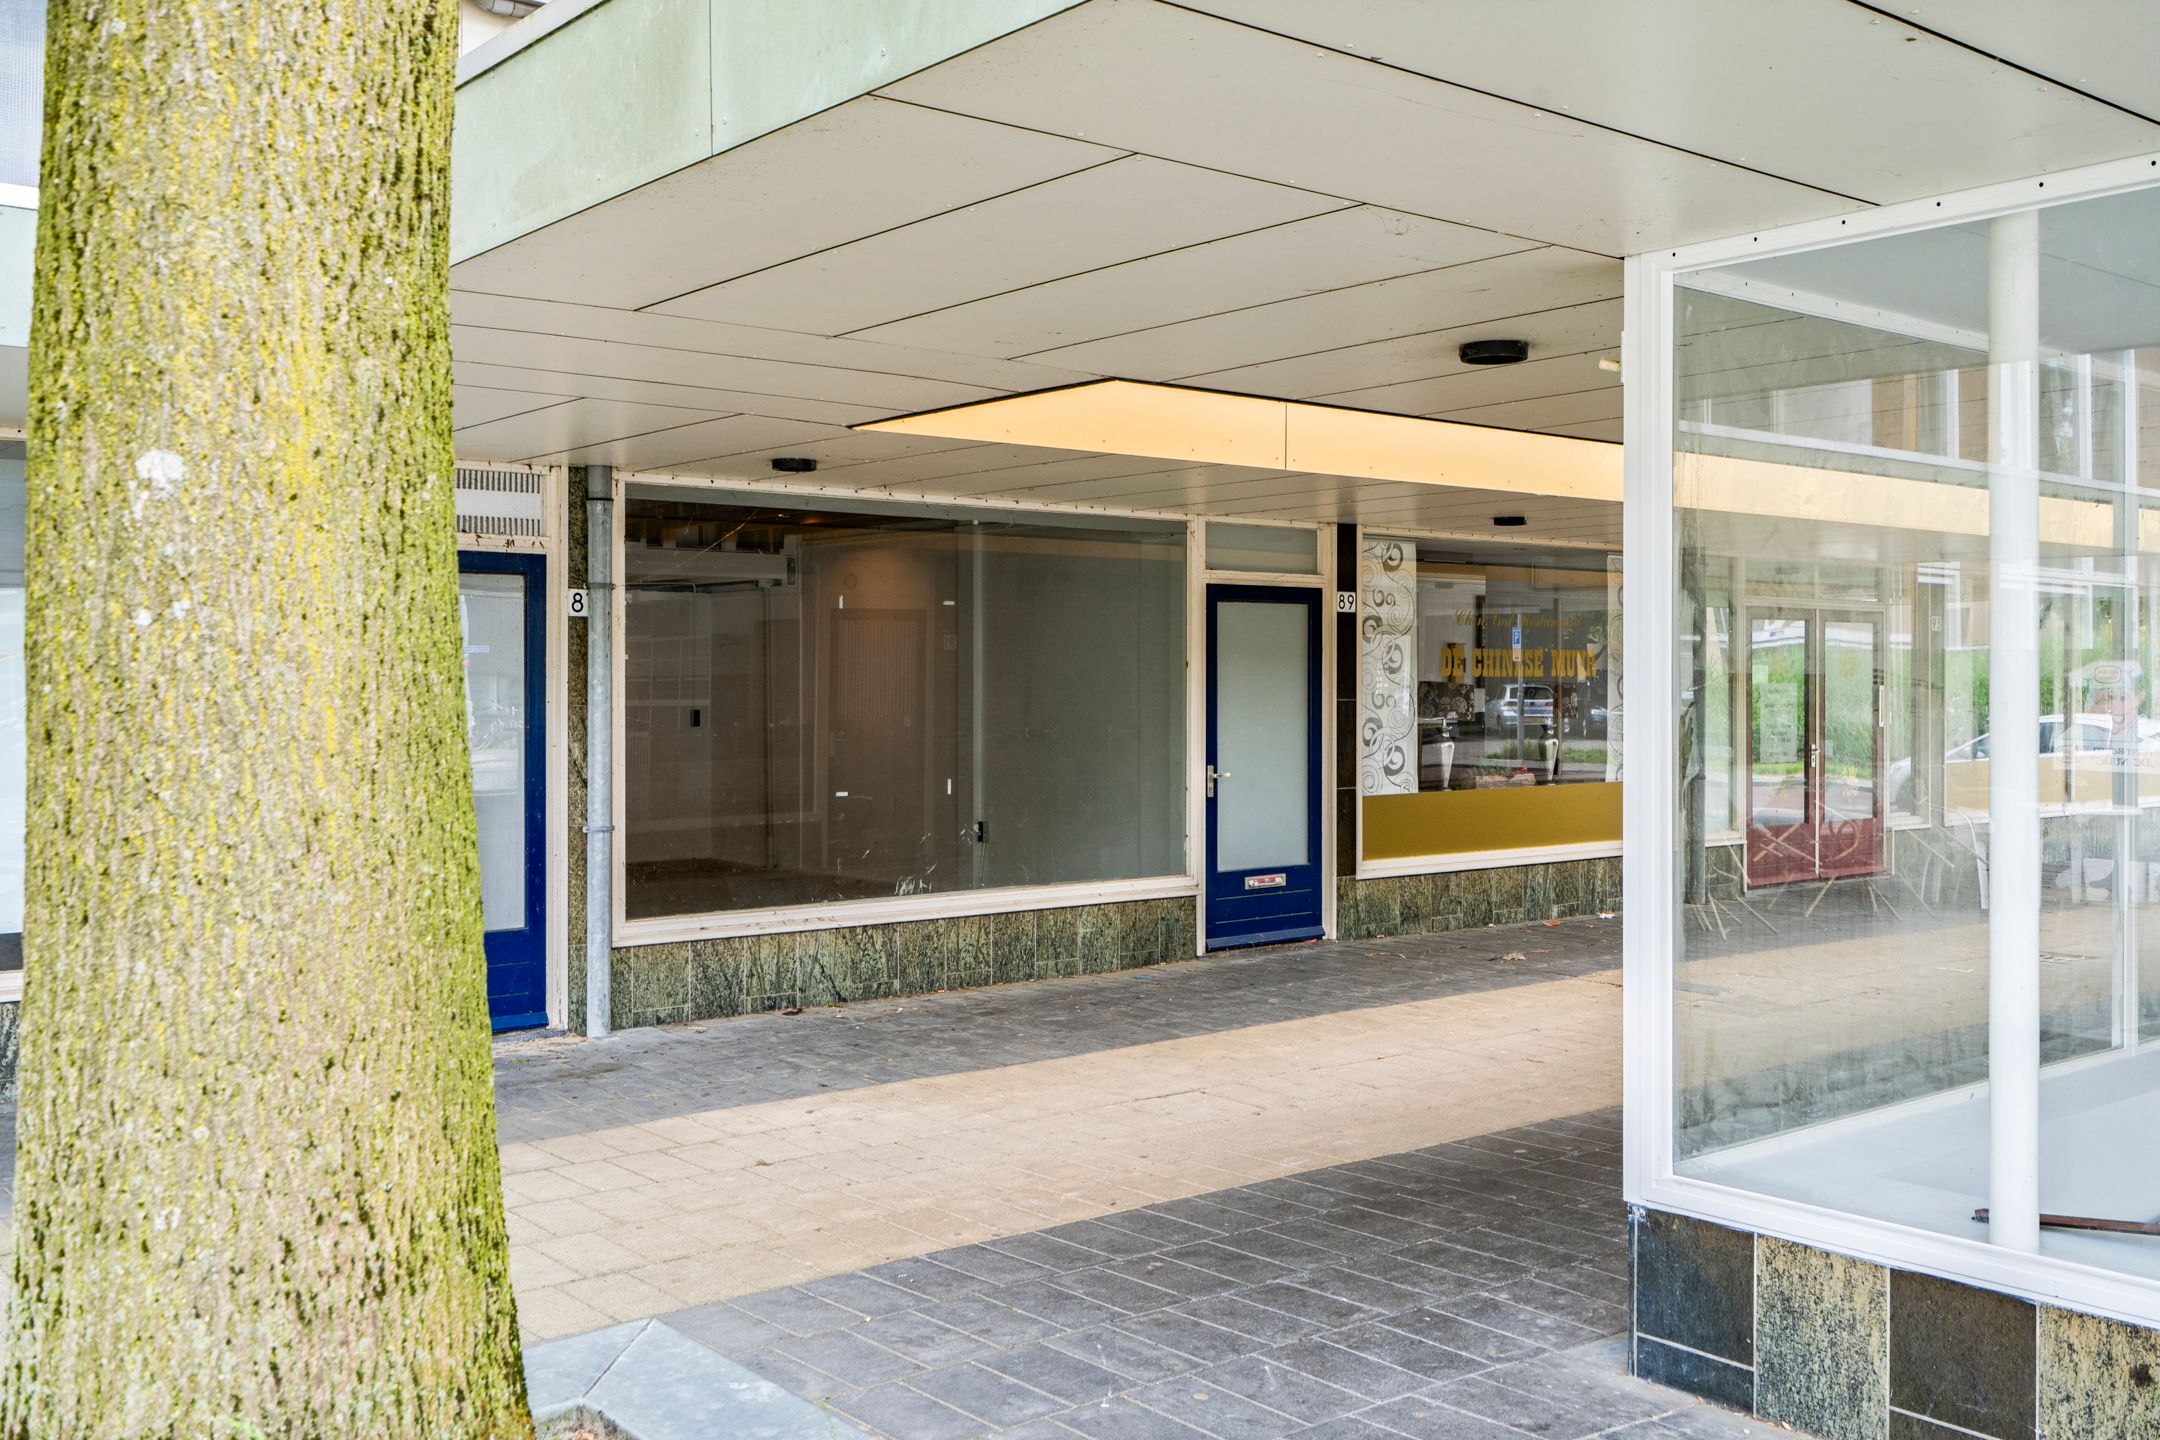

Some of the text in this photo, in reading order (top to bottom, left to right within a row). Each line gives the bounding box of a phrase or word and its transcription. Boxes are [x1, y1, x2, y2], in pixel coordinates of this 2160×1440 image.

[571, 592, 588, 613] 8
[1339, 594, 1354, 610] 89
[1440, 648, 1466, 678] DE
